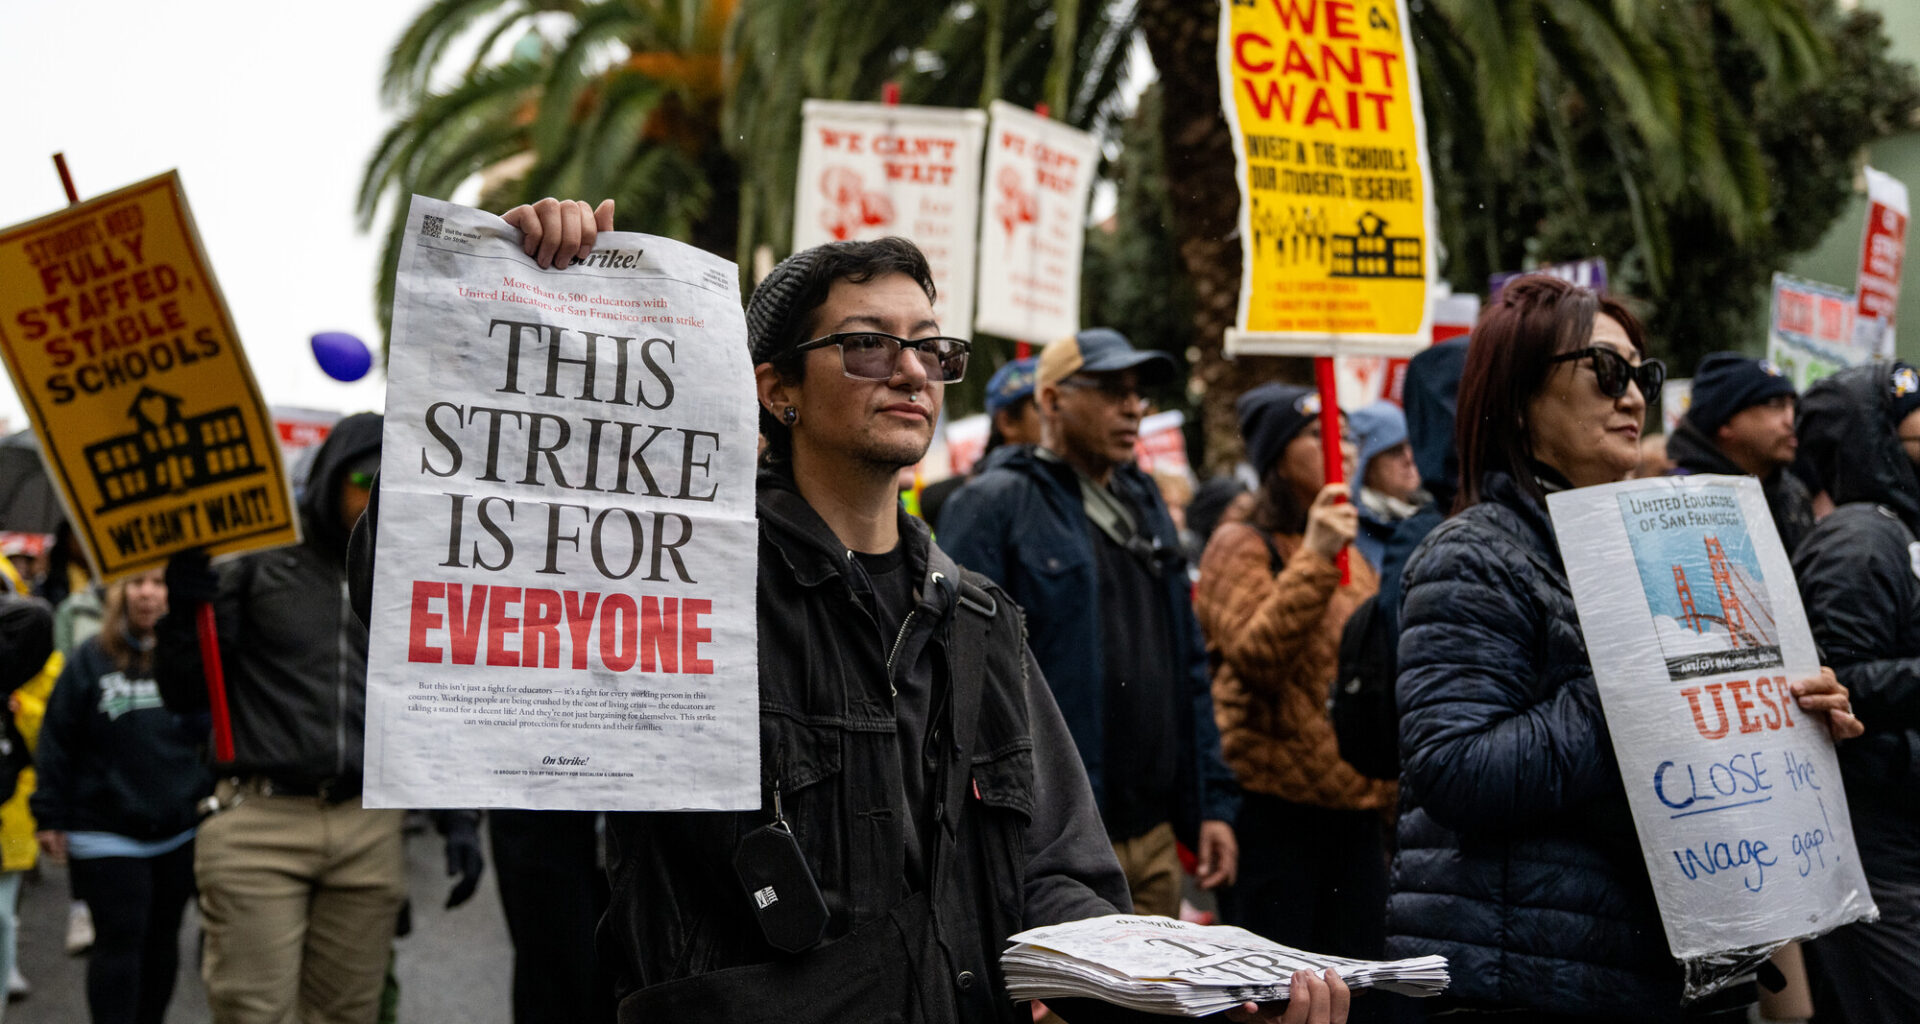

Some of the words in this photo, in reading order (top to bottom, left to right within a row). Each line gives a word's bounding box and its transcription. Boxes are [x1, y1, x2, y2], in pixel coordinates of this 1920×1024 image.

[1271, 0, 1359, 40] WE
[1234, 33, 1398, 88] CANT
[1241, 77, 1394, 131] WAIT
[1313, 141, 1337, 167] THE
[39, 234, 144, 296] FULLY
[503, 276, 531, 291] More
[533, 285, 555, 299] than
[558, 292, 588, 304] 6,500
[590, 294, 640, 308] educators
[643, 298, 668, 308] with
[16, 263, 193, 341] STAFFED,
[459, 287, 498, 300] United
[501, 291, 552, 311] Educators
[554, 304, 566, 313] of
[567, 305, 587, 317] San
[589, 308, 639, 322] Francisco
[641, 315, 657, 323] are
[660, 315, 674, 324] on
[676, 316, 705, 328] strike!
[45, 301, 187, 368] STABLE
[46, 327, 221, 404] SCHOOLS
[488, 319, 675, 411] THIS
[421, 401, 720, 502] STRIKE
[203, 485, 274, 534] WAIT!
[1630, 496, 1681, 515] UNITED
[1660, 513, 1687, 530] SAN
[438, 493, 515, 571] IS
[535, 502, 698, 584] FOR
[408, 580, 714, 675] EVERYONE
[408, 695, 439, 704] country.
[441, 694, 473, 705] Working
[474, 696, 497, 705] people
[511, 696, 532, 707] being
[562, 698, 570, 708] by
[572, 699, 583, 707] the
[608, 699, 628, 710] living
[630, 701, 647, 709] crisis
[671, 702, 704, 710] educators
[408, 704, 431, 714] taking
[460, 705, 471, 713] for
[478, 706, 501, 714] decent
[519, 708, 535, 716] And
[536, 708, 562, 719] they're
[575, 710, 588, 719] just
[589, 711, 627, 721] bargaining
[639, 712, 678, 720] themselves.
[680, 713, 696, 721] This
[697, 713, 717, 721] strike
[419, 681, 432, 690] But
[435, 682, 448, 690] this
[450, 683, 465, 691] isn't
[467, 684, 480, 693] just
[488, 684, 504, 694] fight
[507, 685, 517, 693] for
[519, 685, 553, 694] educators
[564, 687, 575, 695] it's
[581, 687, 598, 699] fight
[598, 689, 609, 697] for
[610, 690, 628, 700] every
[630, 690, 659, 700] working
[660, 692, 683, 700] person
[693, 691, 706, 699] this
[1680, 676, 1795, 740] UESF
[518, 720, 559, 729] protections
[560, 720, 571, 728] for
[572, 721, 601, 729] students
[602, 722, 616, 730] and
[617, 722, 634, 730] their
[635, 722, 664, 731] families.
[542, 755, 556, 765] On
[557, 755, 590, 766] Strike!
[1654, 751, 1772, 809] CLOSE
[1783, 751, 1821, 792] the
[1792, 796, 1841, 877] gap!
